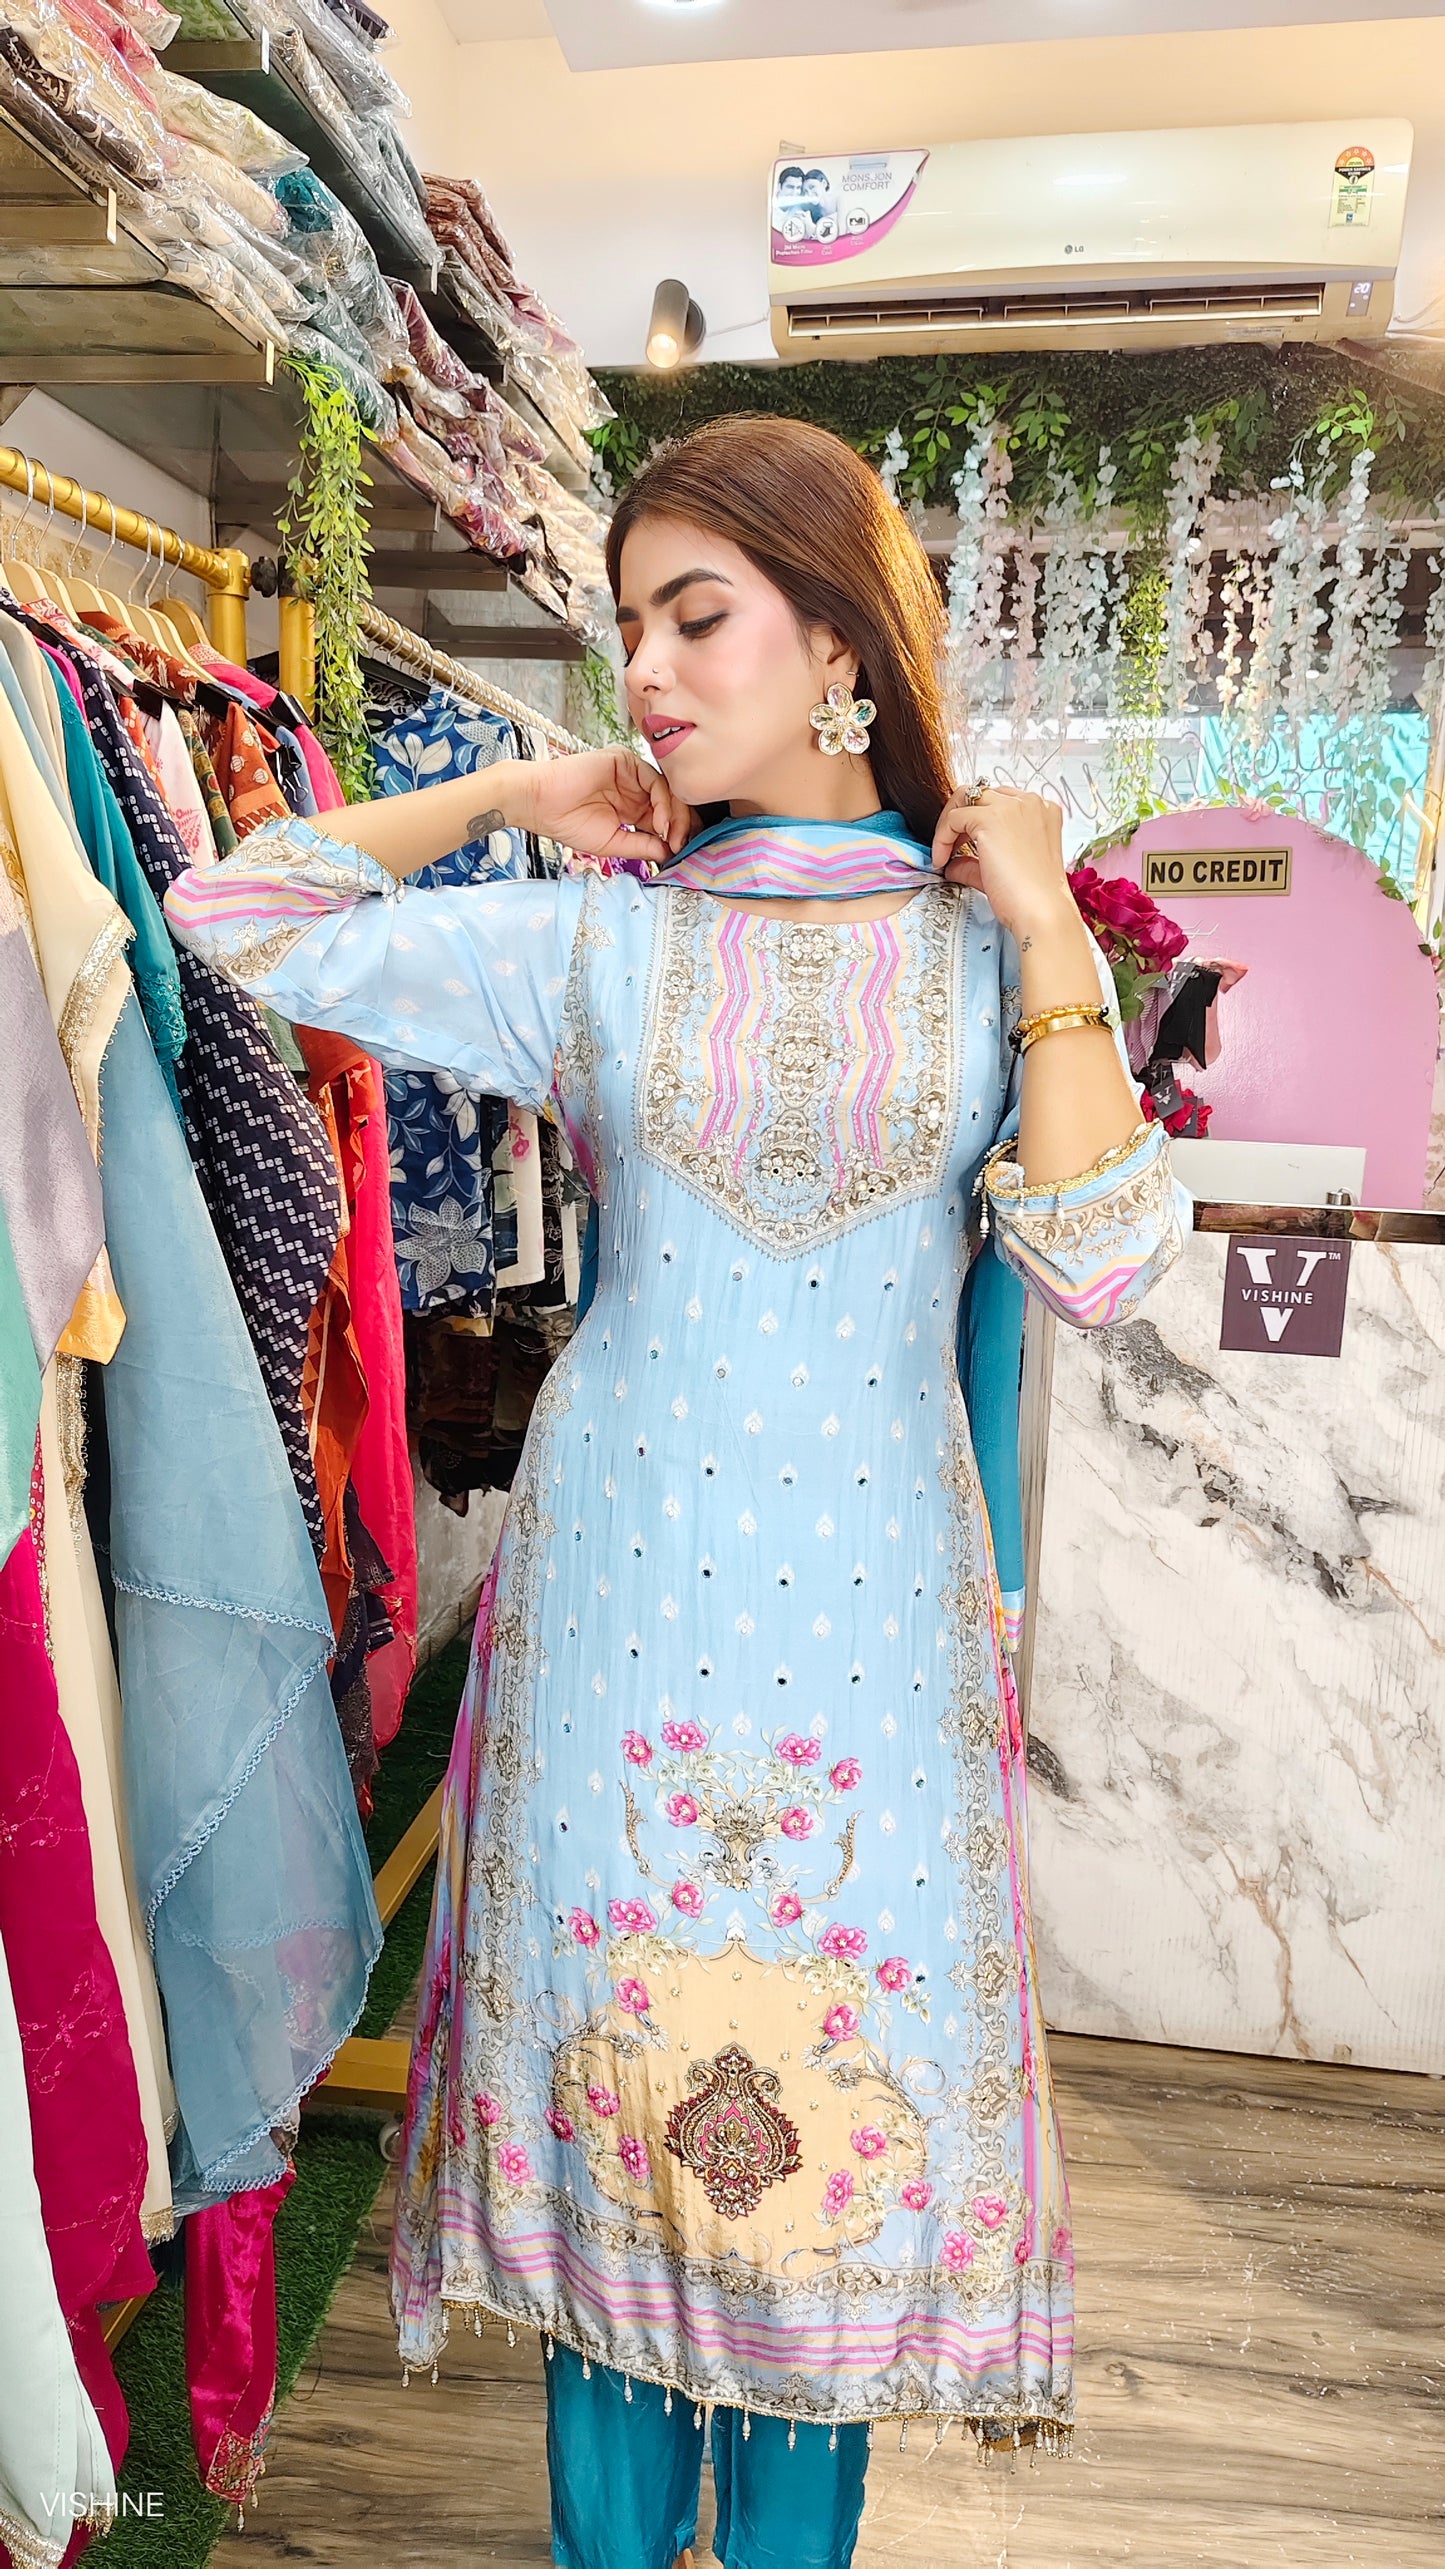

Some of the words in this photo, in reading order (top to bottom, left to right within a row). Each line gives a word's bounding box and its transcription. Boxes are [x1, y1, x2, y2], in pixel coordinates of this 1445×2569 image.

[842, 182, 889, 192] COMFORT
[1354, 282, 1371, 294] 20
[1150, 861, 1184, 884] NO
[1193, 859, 1283, 883] CREDIT
[1241, 1288, 1313, 1305] VISHINE
